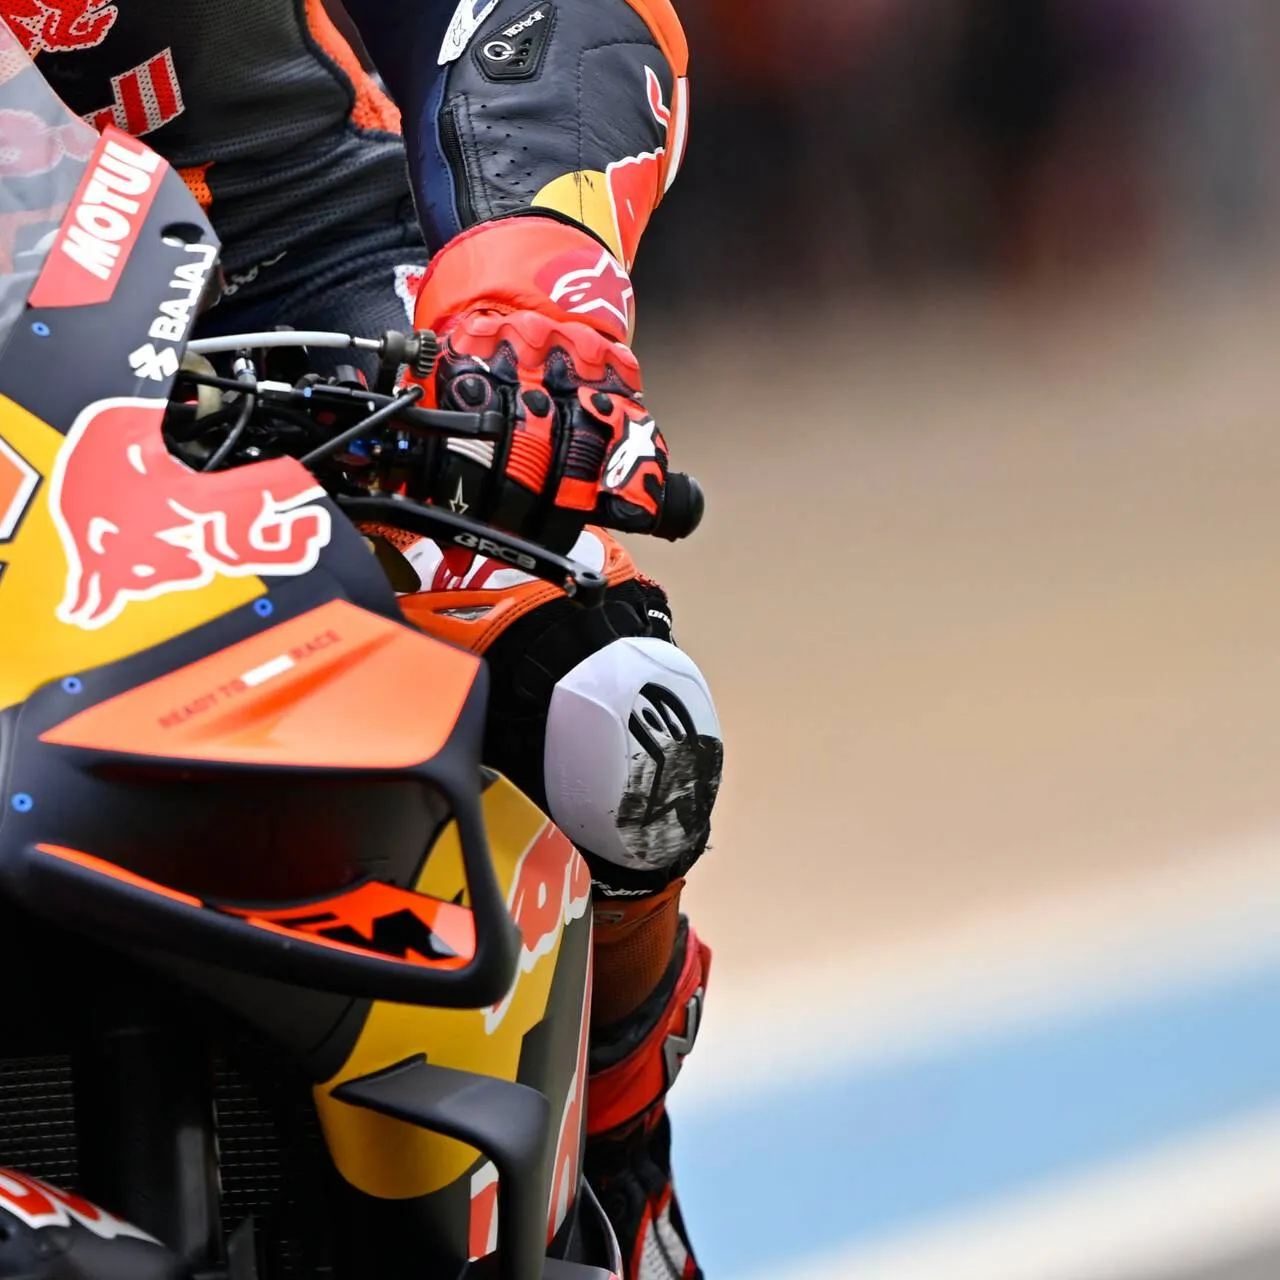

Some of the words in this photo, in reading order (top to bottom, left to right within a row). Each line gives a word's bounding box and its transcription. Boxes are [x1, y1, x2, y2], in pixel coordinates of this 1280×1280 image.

[61, 139, 160, 281] MOTUL
[148, 242, 218, 342] BAJAJ
[477, 538, 538, 570] RCB
[289, 628, 342, 660] RACE
